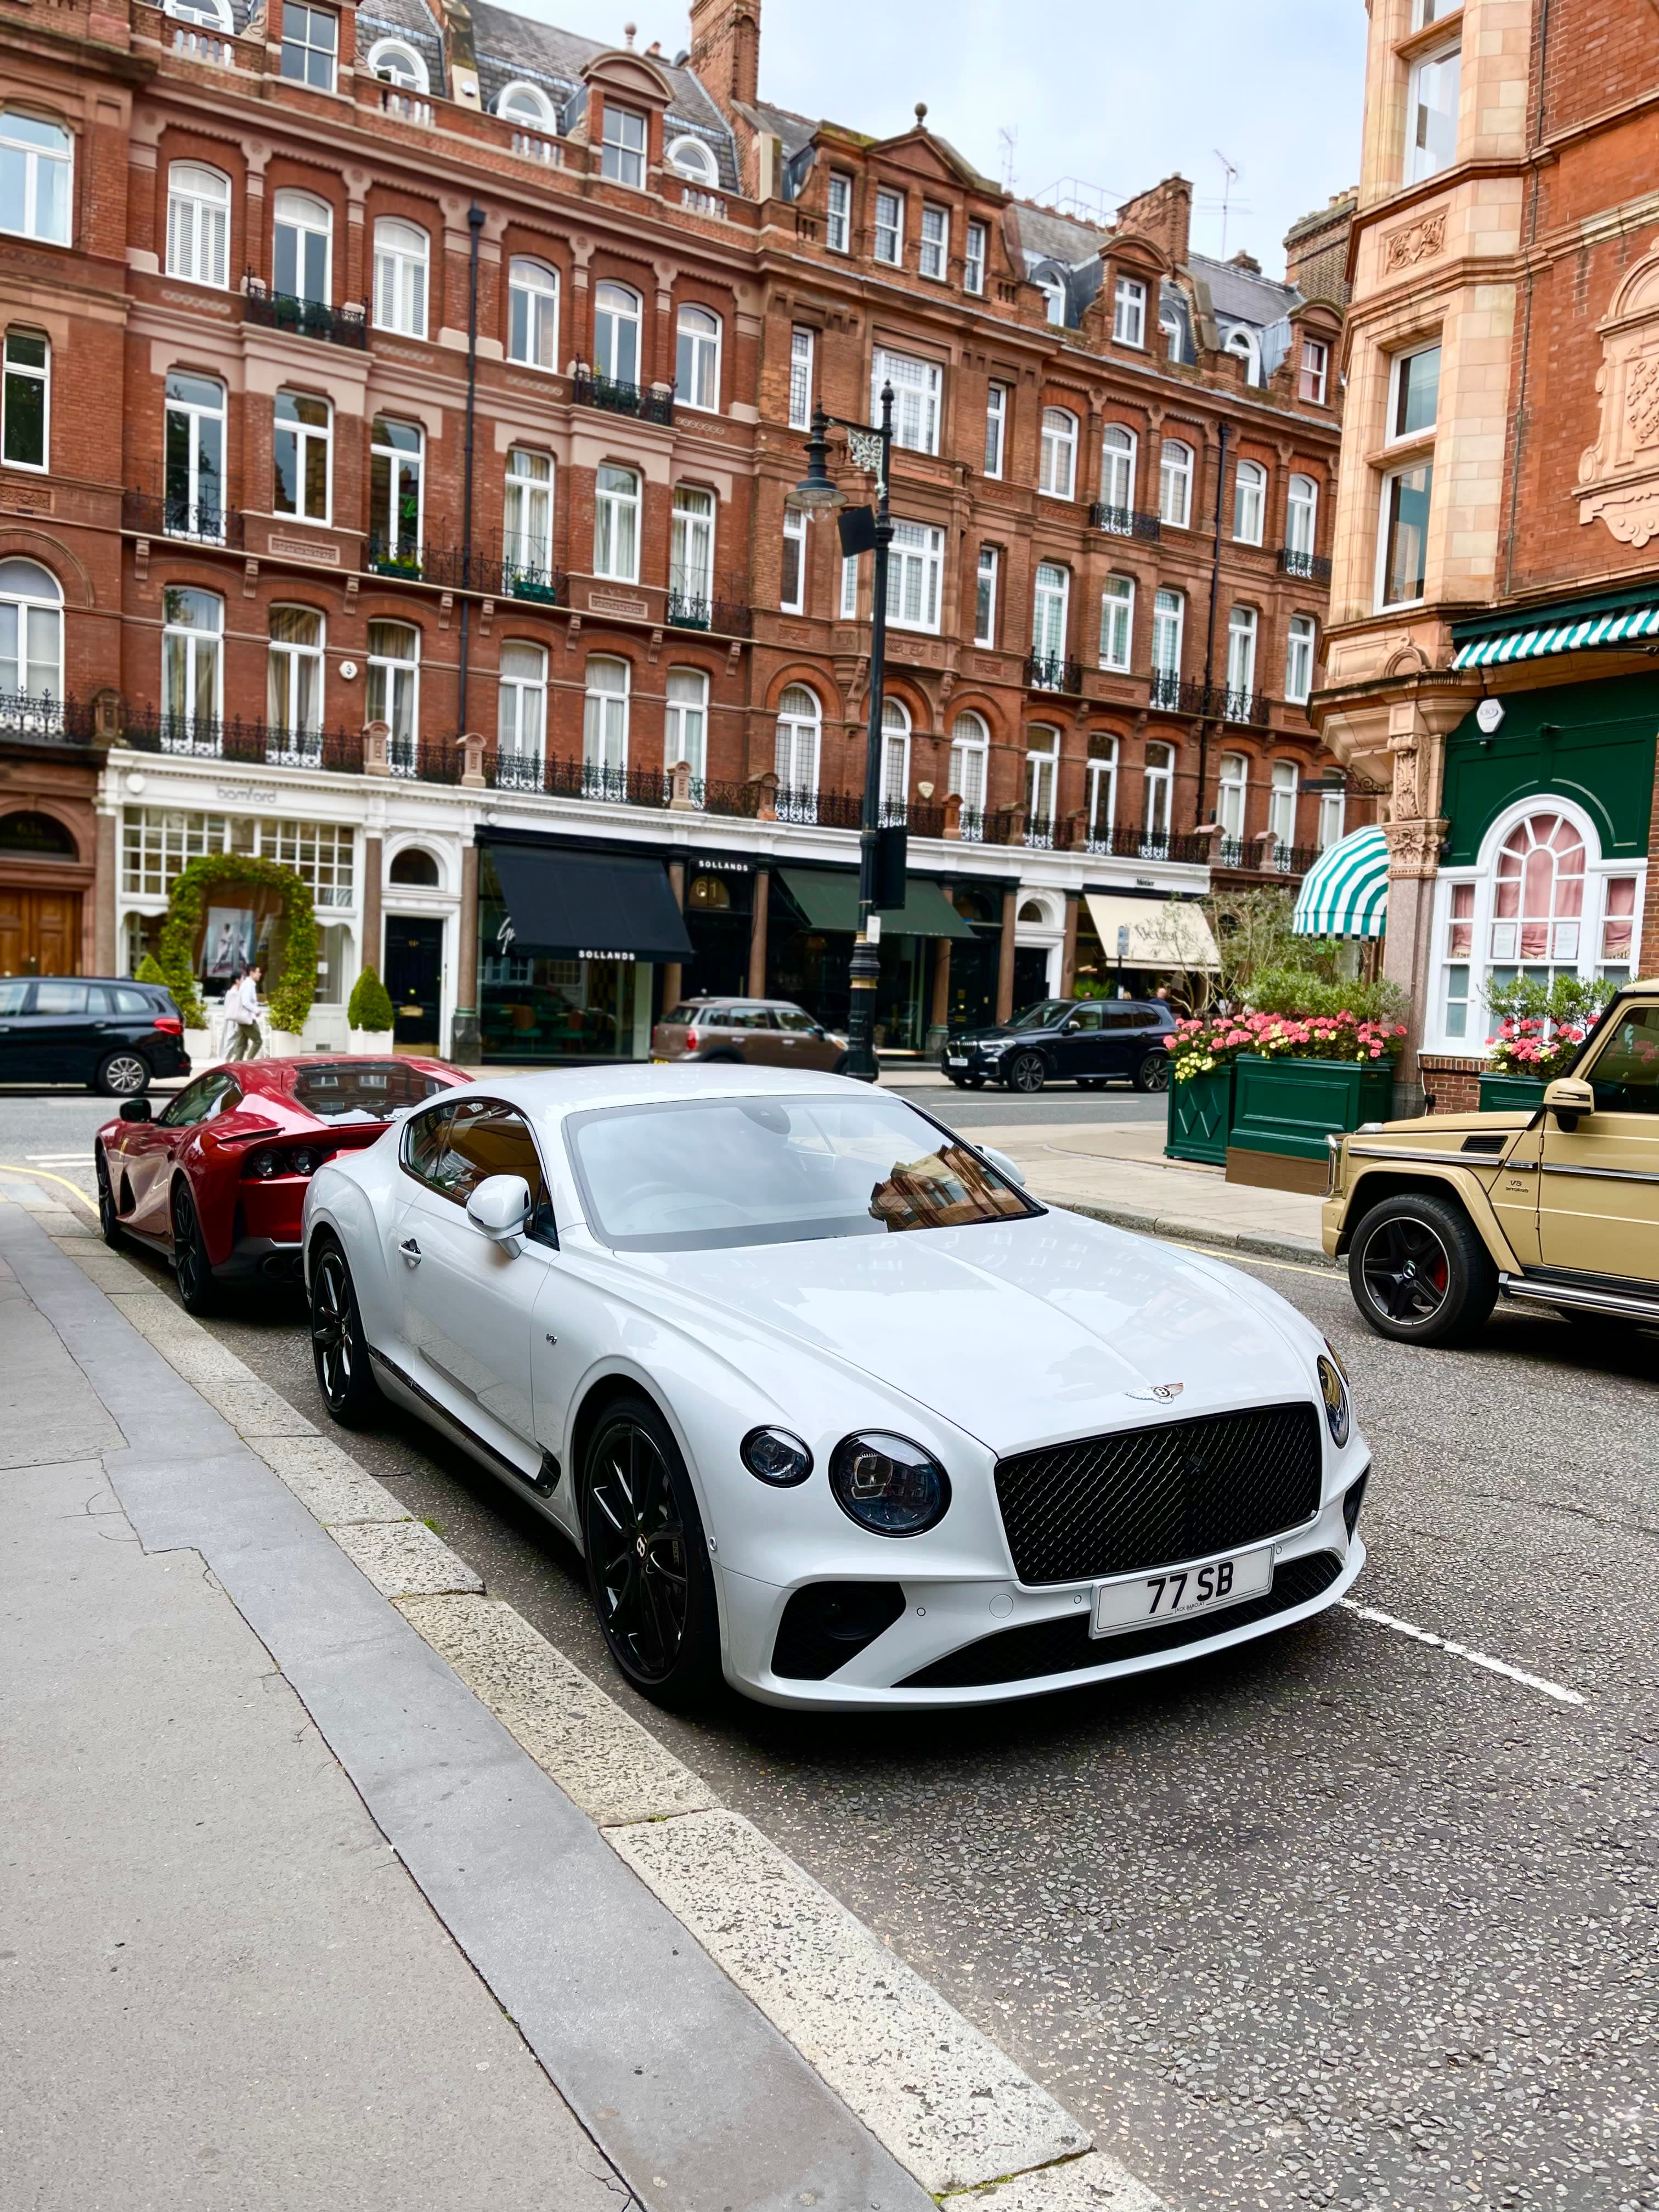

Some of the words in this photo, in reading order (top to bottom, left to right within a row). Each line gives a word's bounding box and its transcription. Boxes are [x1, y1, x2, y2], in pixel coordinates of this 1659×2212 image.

[1627, 361, 1659, 407] CHAP
[216, 785, 276, 803] bamford
[699, 860, 748, 872] SOLLANDS
[696, 881, 716, 898] 61
[579, 950, 635, 961] SOLLANDS
[1147, 1573, 1188, 1614] 77
[1197, 1562, 1233, 1601] SB
[1186, 1601, 1205, 1611] BARCLAY
